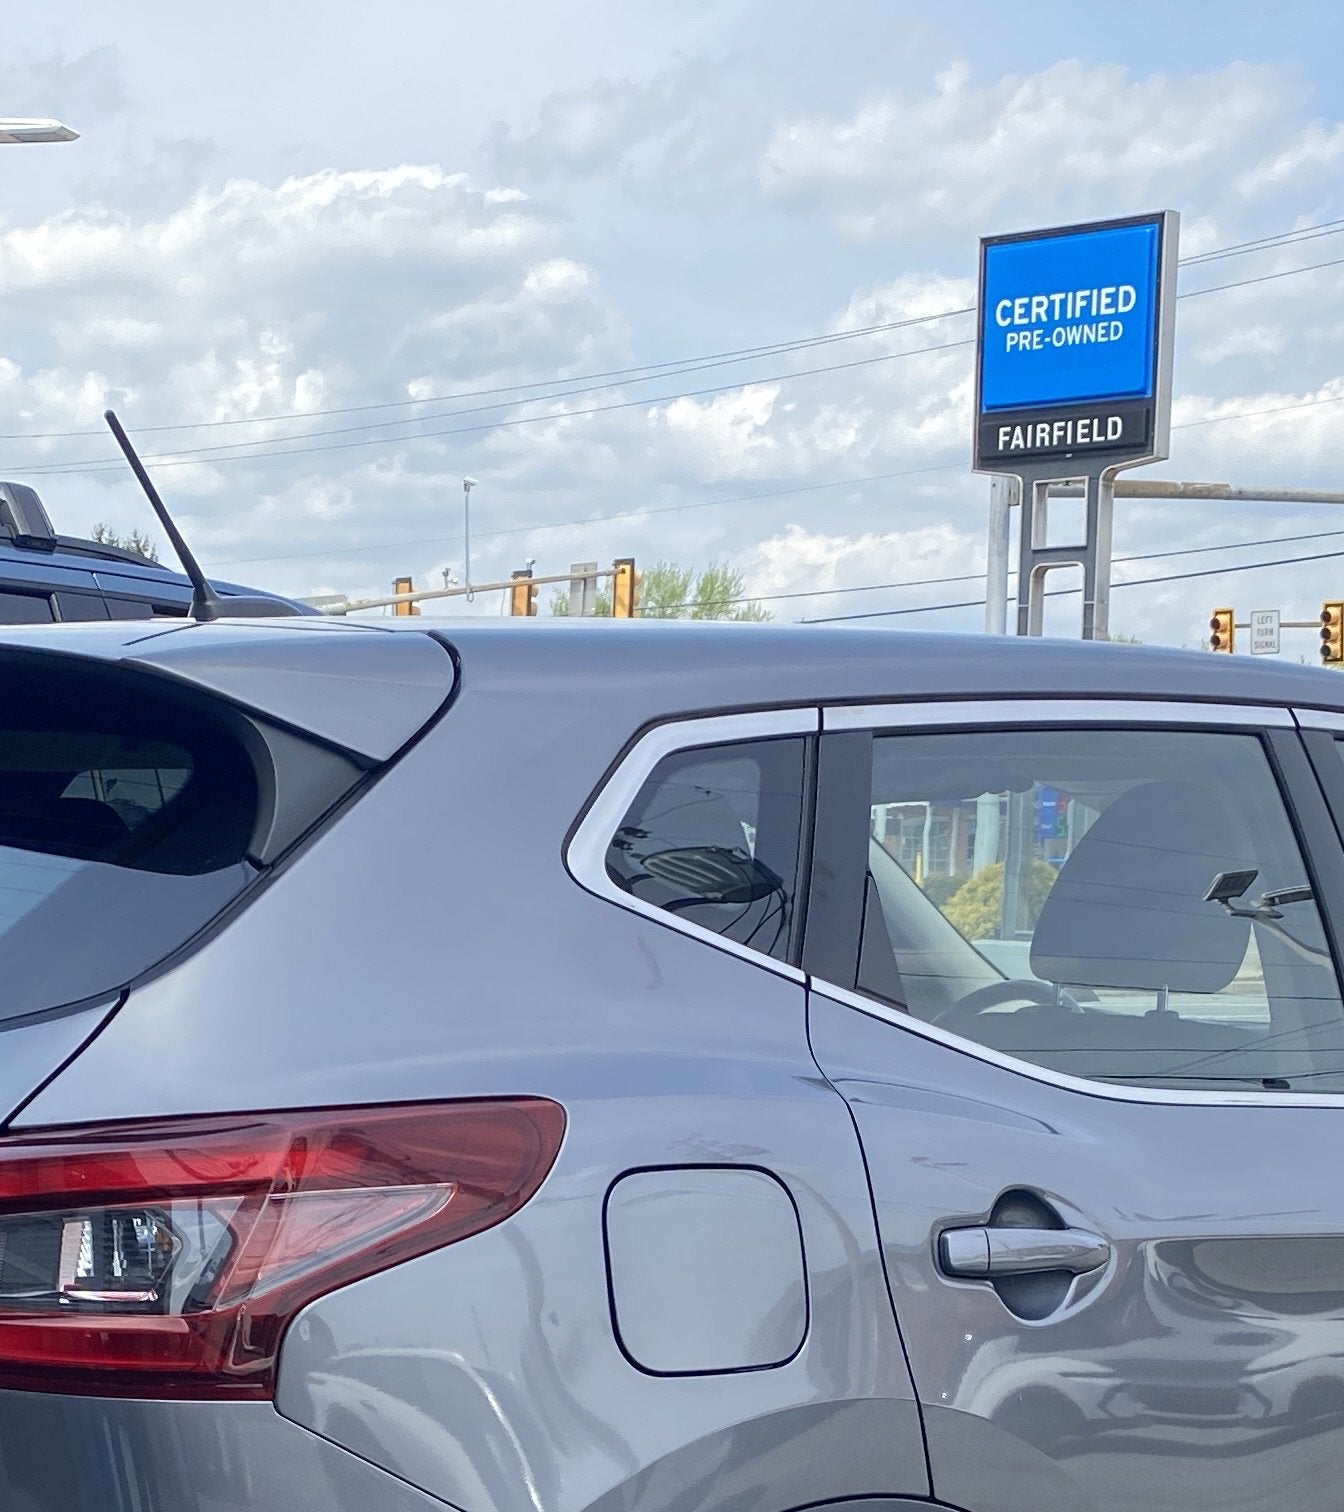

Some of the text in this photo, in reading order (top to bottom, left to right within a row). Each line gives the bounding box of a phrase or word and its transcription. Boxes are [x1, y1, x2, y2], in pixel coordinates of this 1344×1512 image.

[995, 285, 1137, 327] CERTIFIED
[1006, 321, 1123, 352] PRE-OWNED
[998, 416, 1123, 451] FAIRFIELD
